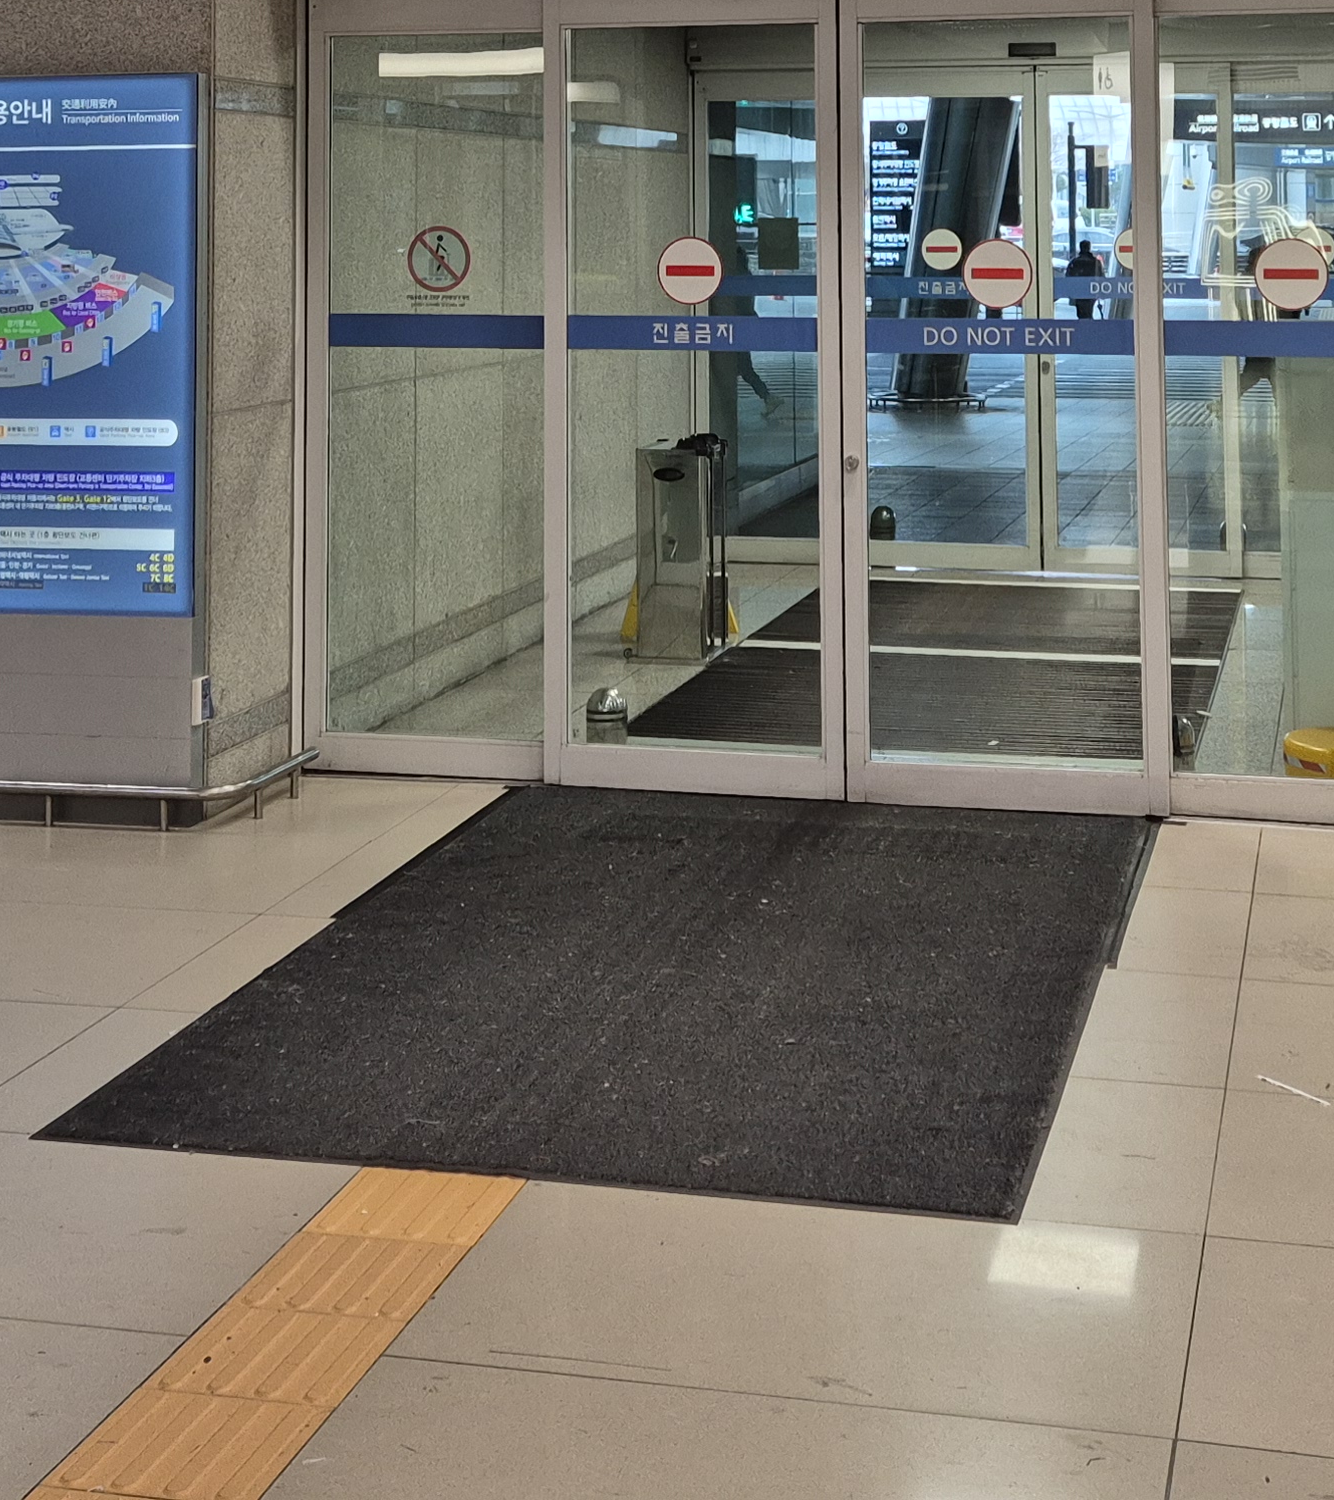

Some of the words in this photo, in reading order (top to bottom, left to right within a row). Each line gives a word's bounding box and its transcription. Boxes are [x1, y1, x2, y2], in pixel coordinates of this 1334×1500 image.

[61, 114, 126, 126] Transportation
[127, 112, 179, 123] Information
[1089, 282, 1113, 294] DO
[1162, 282, 1187, 294] XIT
[652, 322, 735, 345] 진출금지
[923, 326, 957, 346] DO
[967, 326, 1015, 346] NOT
[1025, 327, 1075, 347] EXIT
